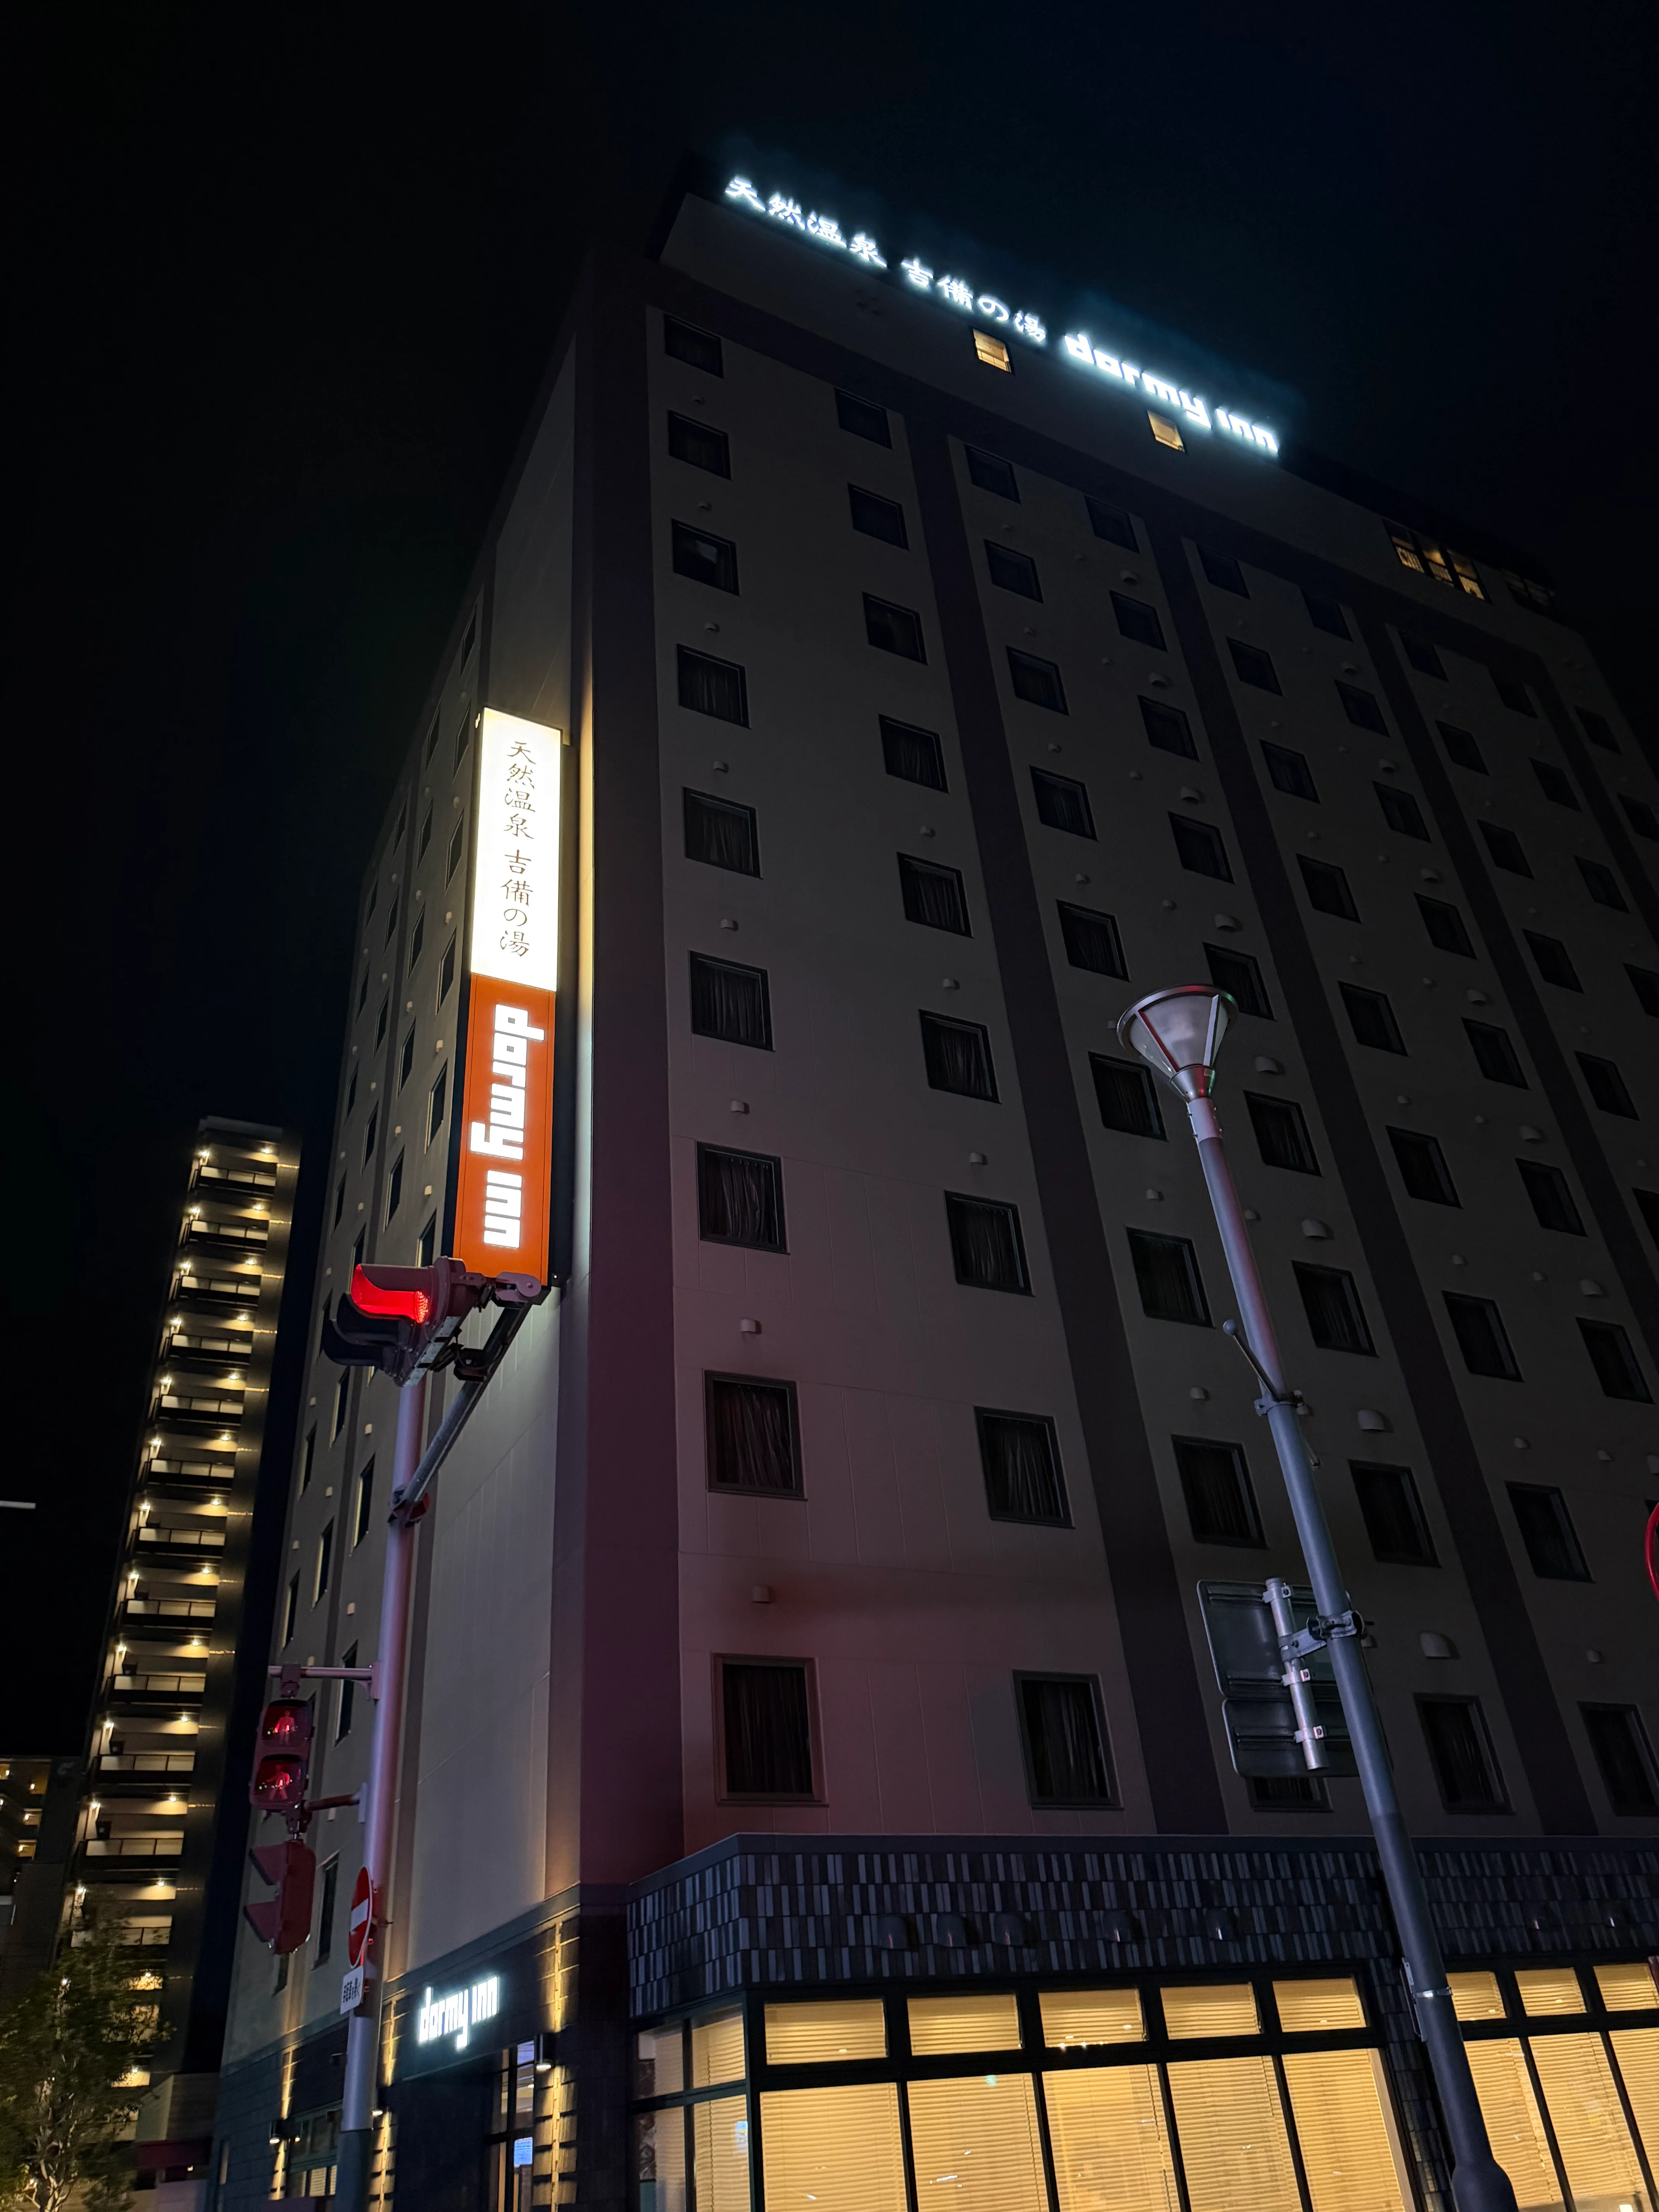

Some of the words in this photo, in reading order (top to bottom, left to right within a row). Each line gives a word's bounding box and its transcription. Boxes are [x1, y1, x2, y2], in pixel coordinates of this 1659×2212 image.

[724, 178, 887, 268] 天然温泉
[901, 260, 1046, 342] 吉備の湯
[1064, 333, 1212, 429] dormy
[1216, 408, 1278, 452] inn
[503, 741, 536, 840] 天然温泉
[500, 849, 534, 957] 吉備の湯
[470, 1003, 544, 1161] dormy
[484, 1170, 522, 1249] inn
[418, 1987, 469, 2049] dormy
[471, 1976, 498, 2024] inn
